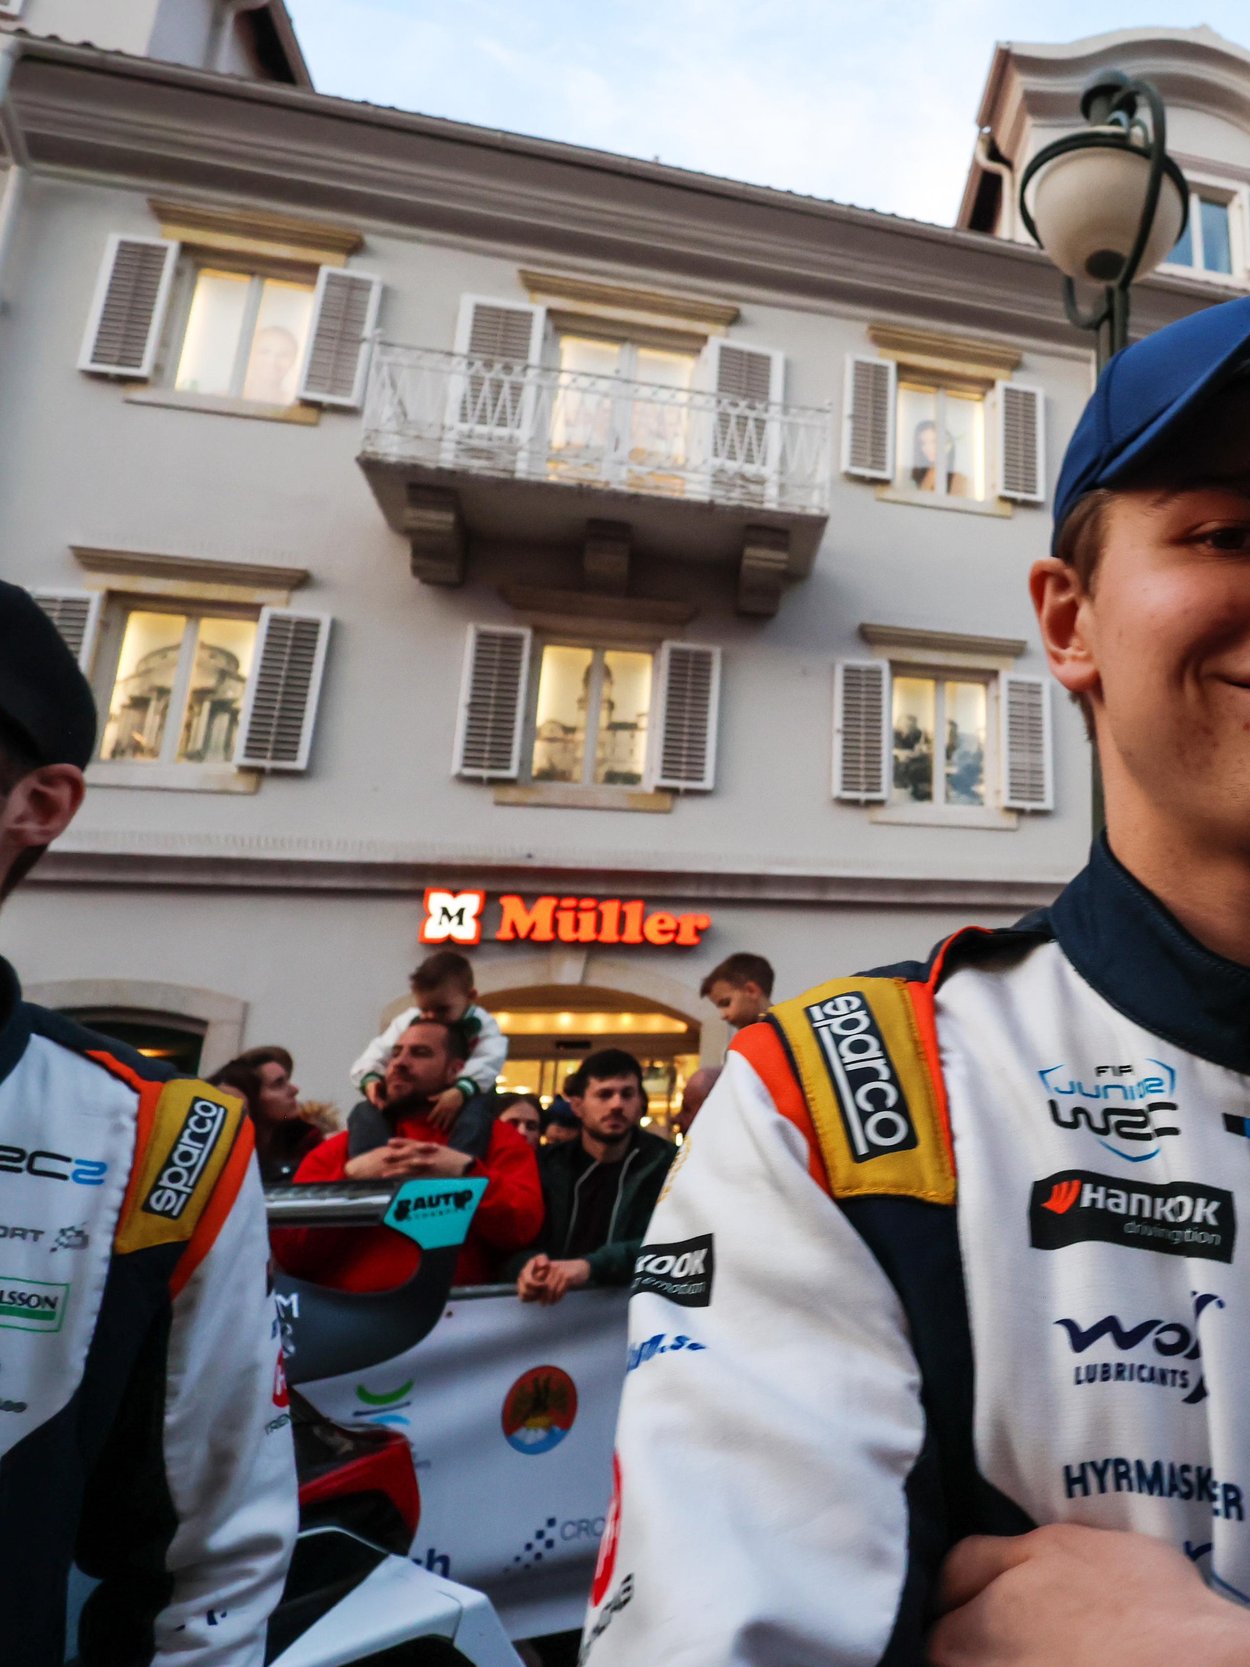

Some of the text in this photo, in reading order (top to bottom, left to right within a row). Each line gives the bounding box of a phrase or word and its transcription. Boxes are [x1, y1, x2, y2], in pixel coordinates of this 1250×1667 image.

[439, 894, 713, 946] M Müller
[812, 994, 909, 1156] sparco
[1048, 1098, 1181, 1141] WRC
[149, 1100, 226, 1217] sparco
[1073, 1362, 1190, 1390] LUBRICANTS
